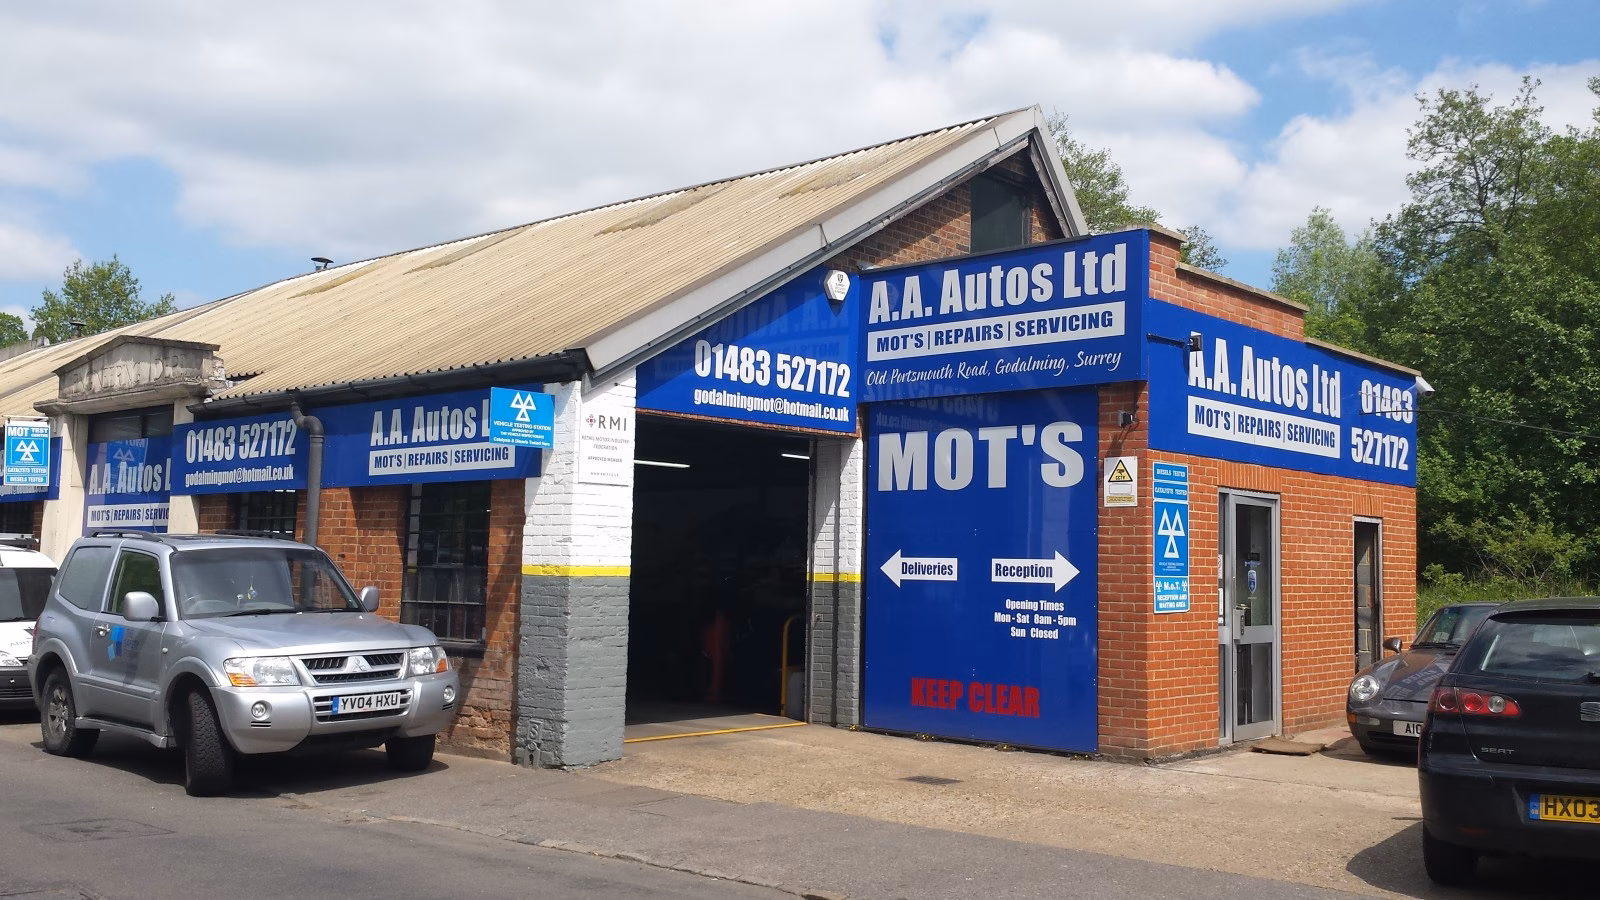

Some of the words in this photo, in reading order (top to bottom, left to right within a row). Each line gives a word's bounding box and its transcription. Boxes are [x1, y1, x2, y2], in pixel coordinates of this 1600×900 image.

[868, 275, 933, 325] A.A.
[939, 262, 1054, 315] Autos
[1063, 243, 1127, 299] Ltd
[876, 332, 924, 353] MOT'S
[934, 323, 1004, 346] REPAIRS
[1014, 310, 1113, 338] SERVICING
[694, 340, 771, 387] 01483
[776, 352, 851, 398] 527172
[866, 370, 887, 387] Old
[890, 363, 954, 385] Portsmouth
[956, 361, 991, 380] Road,
[995, 354, 1070, 378] Godalming,
[1073, 350, 1122, 372] Surrey
[1187, 331, 1237, 395] A.A.
[1240, 344, 1309, 411] Autos
[1312, 363, 1341, 419] Ltd
[693, 388, 850, 422] godalmingmot@hotmail.co.uk
[1361, 379, 1413, 424] 01483
[7, 426, 29, 437] MOT
[370, 408, 408, 447] A.A.
[410, 406, 477, 443] Autos
[598, 414, 627, 432] RMI
[1194, 404, 1231, 431] MOT'S
[1237, 414, 1281, 440] REPAIRS
[1287, 423, 1335, 449] SERVICING
[185, 426, 236, 464] 01483
[239, 419, 297, 460] 527172
[374, 454, 402, 469] MOT'S
[408, 450, 448, 466] REPAIRS
[454, 447, 509, 464] SERVICING
[877, 421, 1085, 492] MOT'S
[1351, 426, 1409, 471] 527172
[89, 462, 115, 495] A.A.
[116, 461, 163, 493] Autos
[185, 464, 294, 488] godalmingmot@hotmail.co.uk
[91, 509, 110, 521] MOT'S
[113, 508, 142, 521] REPAIRS
[901, 561, 954, 577] Deliveries
[994, 562, 1053, 580] Reception
[994, 612, 1011, 623] Mon
[1016, 612, 1030, 624] Sat
[1033, 613, 1052, 625] 8am
[1057, 614, 1077, 627] 5pm
[1005, 598, 1039, 612] Opening
[1039, 600, 1065, 612] Times
[1010, 626, 1026, 638] Sun
[1030, 627, 1059, 640] Closed
[342, 696, 373, 710] YV04
[375, 694, 399, 708] HXU
[911, 677, 963, 710] KEEP
[969, 681, 1041, 719] CLEAR
[1481, 746, 1515, 755] SEAT
